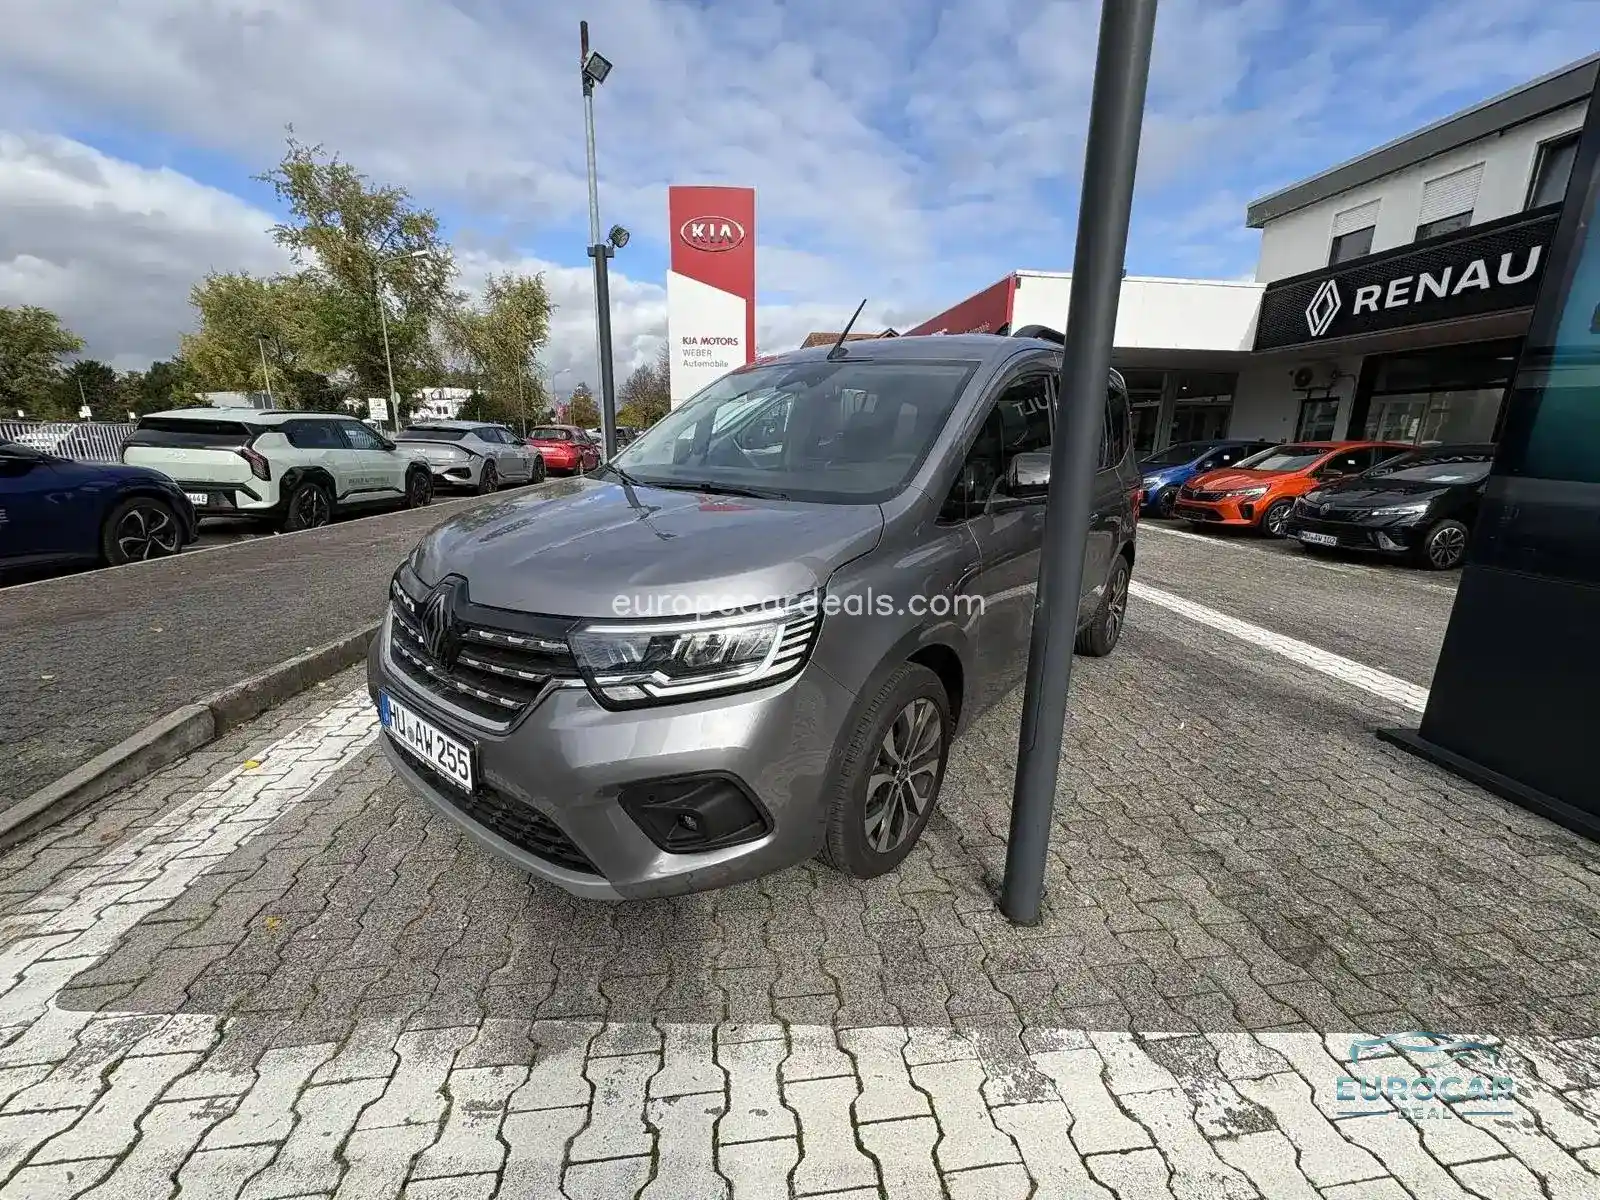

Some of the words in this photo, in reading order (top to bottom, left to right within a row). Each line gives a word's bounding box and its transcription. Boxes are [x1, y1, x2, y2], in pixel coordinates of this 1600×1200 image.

[691, 223, 734, 239] KIA
[1353, 245, 1542, 315] RENAU
[682, 336, 698, 345] KIA
[700, 337, 739, 346] MOTORS
[682, 349, 712, 358] WEBER
[682, 359, 729, 368] Automobile
[389, 701, 406, 736] HU
[415, 721, 433, 758] AW
[437, 735, 468, 780] 255
